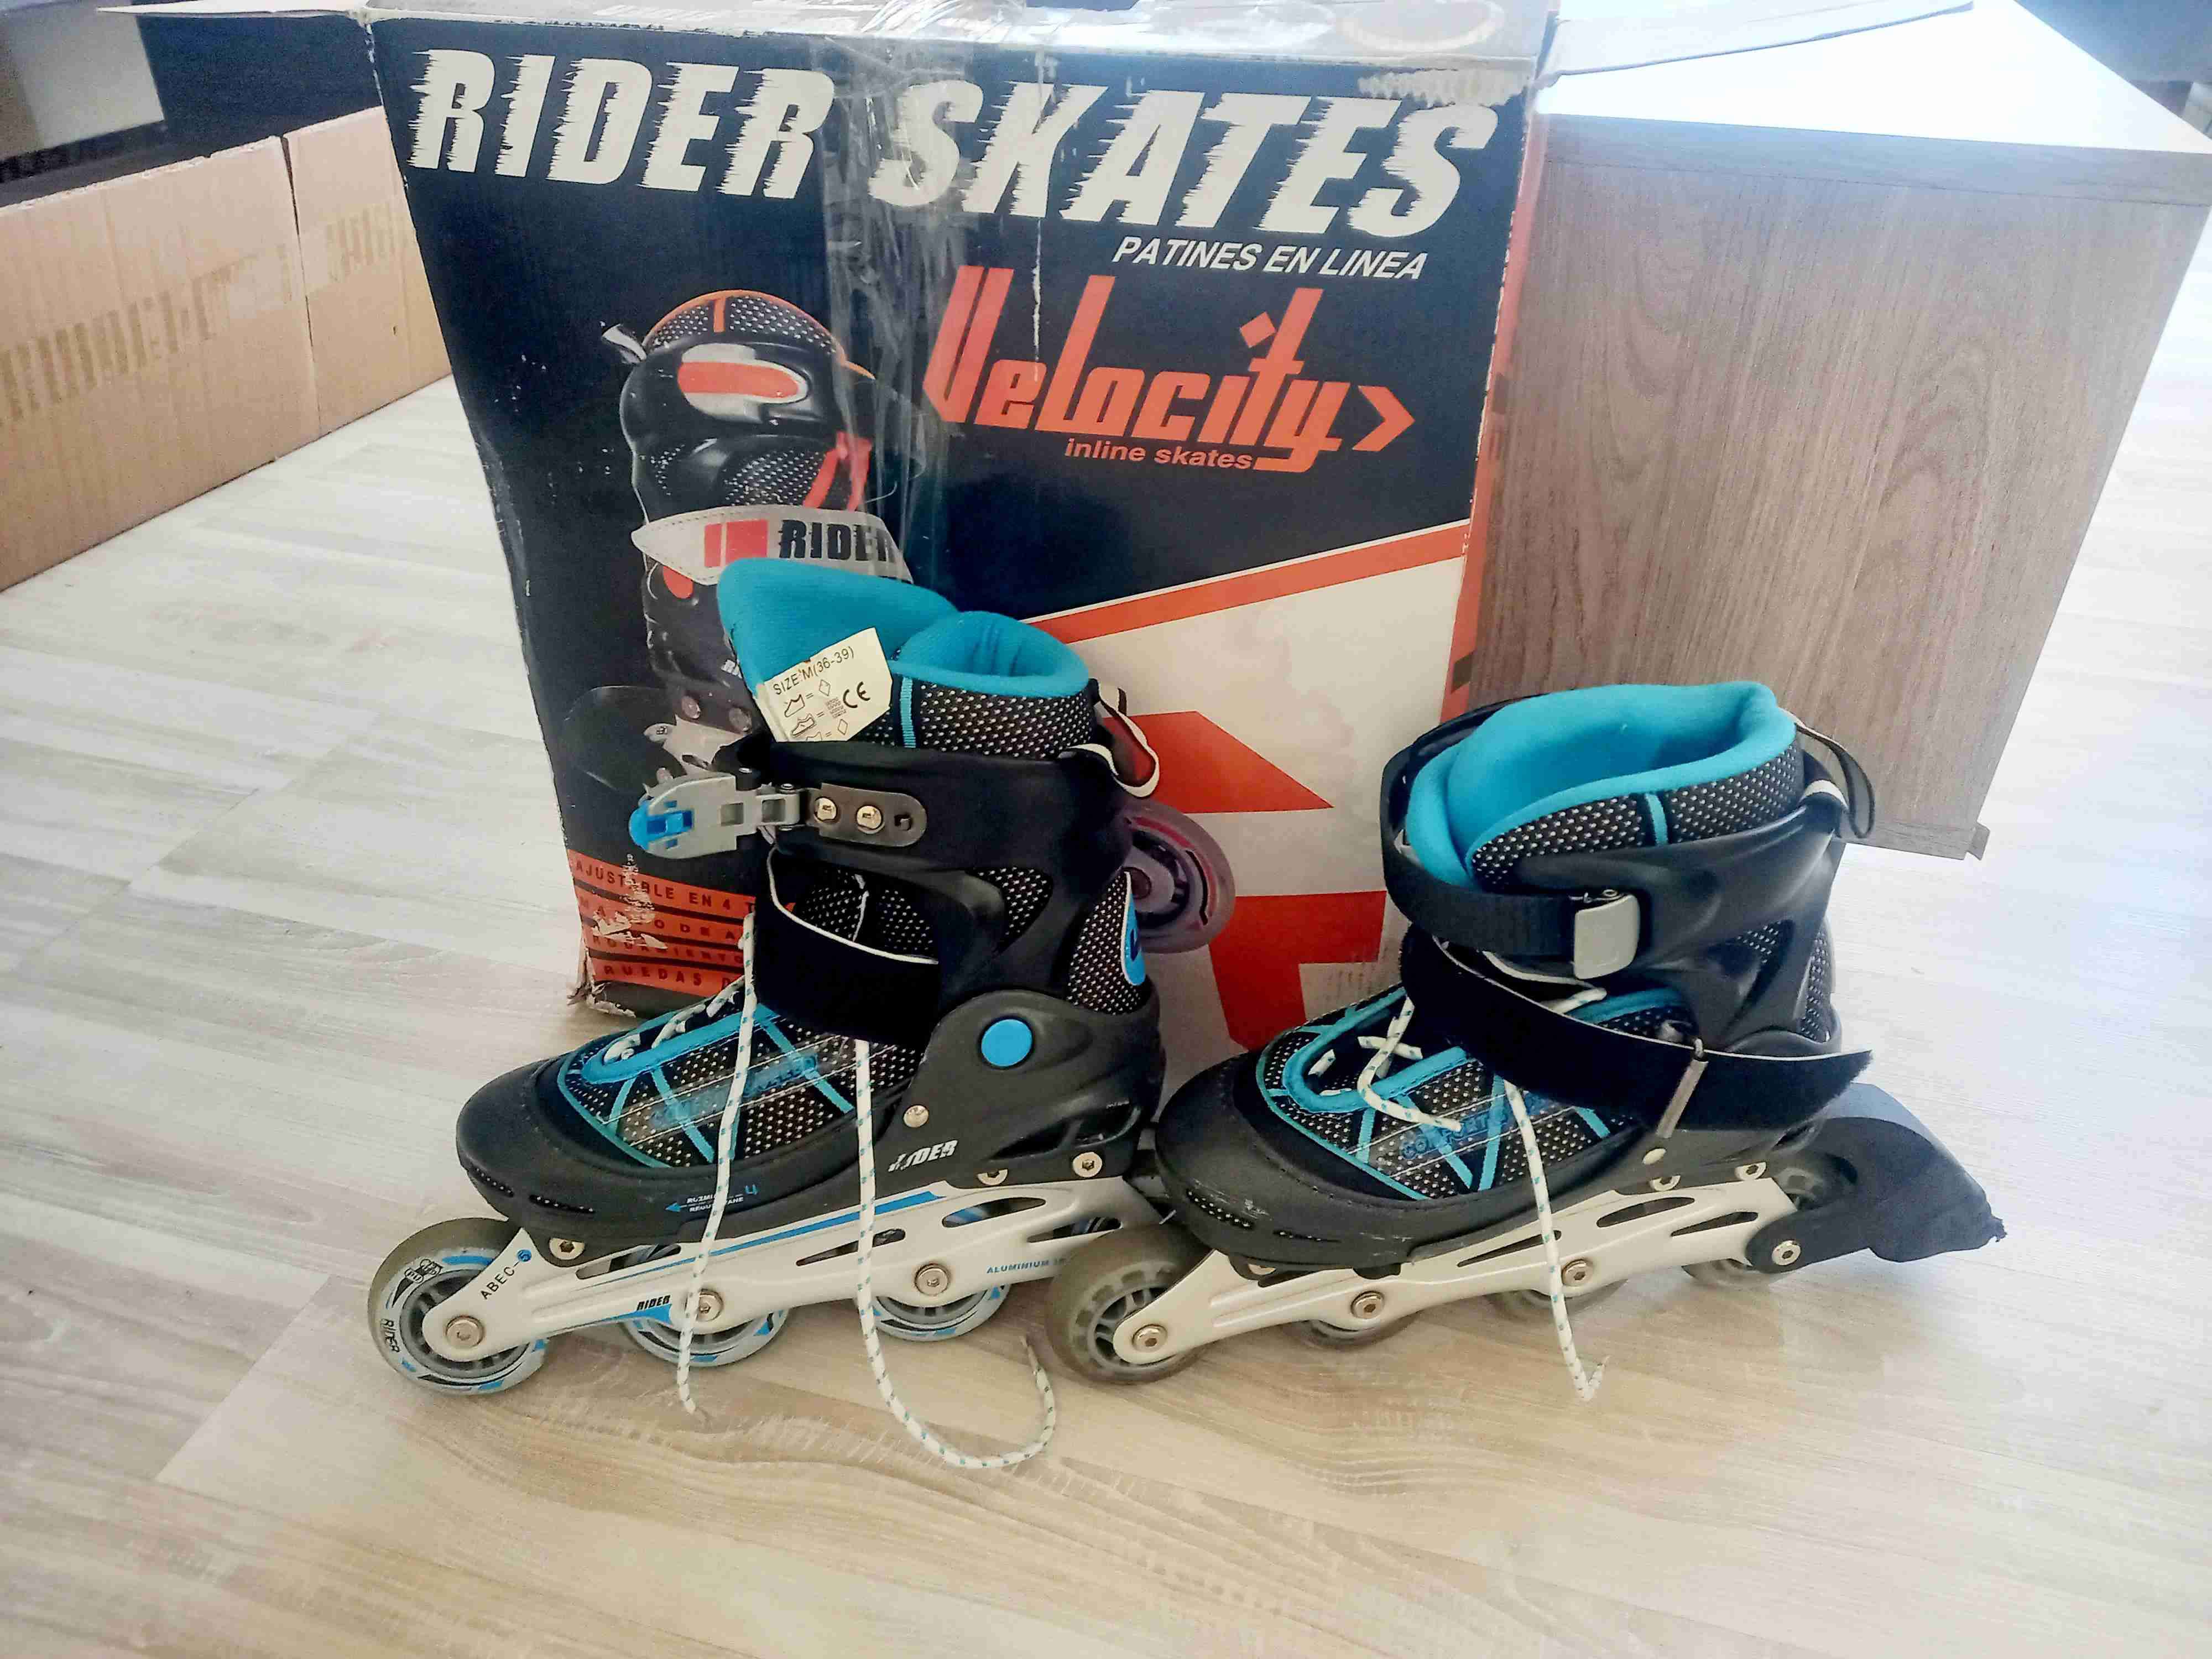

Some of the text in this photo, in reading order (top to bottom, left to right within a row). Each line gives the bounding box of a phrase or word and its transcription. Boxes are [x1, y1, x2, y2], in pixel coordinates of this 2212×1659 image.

[409, 49, 1498, 237] RIDER SKATES
[1111, 236, 1428, 280] PATINES EN LINEA
[1065, 437, 1253, 469] inline skates
[576, 860, 674, 900] AJUSTBLE
[688, 892, 712, 907] EN
[722, 899, 731, 911] 4
[603, 964, 702, 986] RUEDAS
[986, 1259, 1050, 1274] ALUMINIUM
[637, 1295, 671, 1311] RIDER
